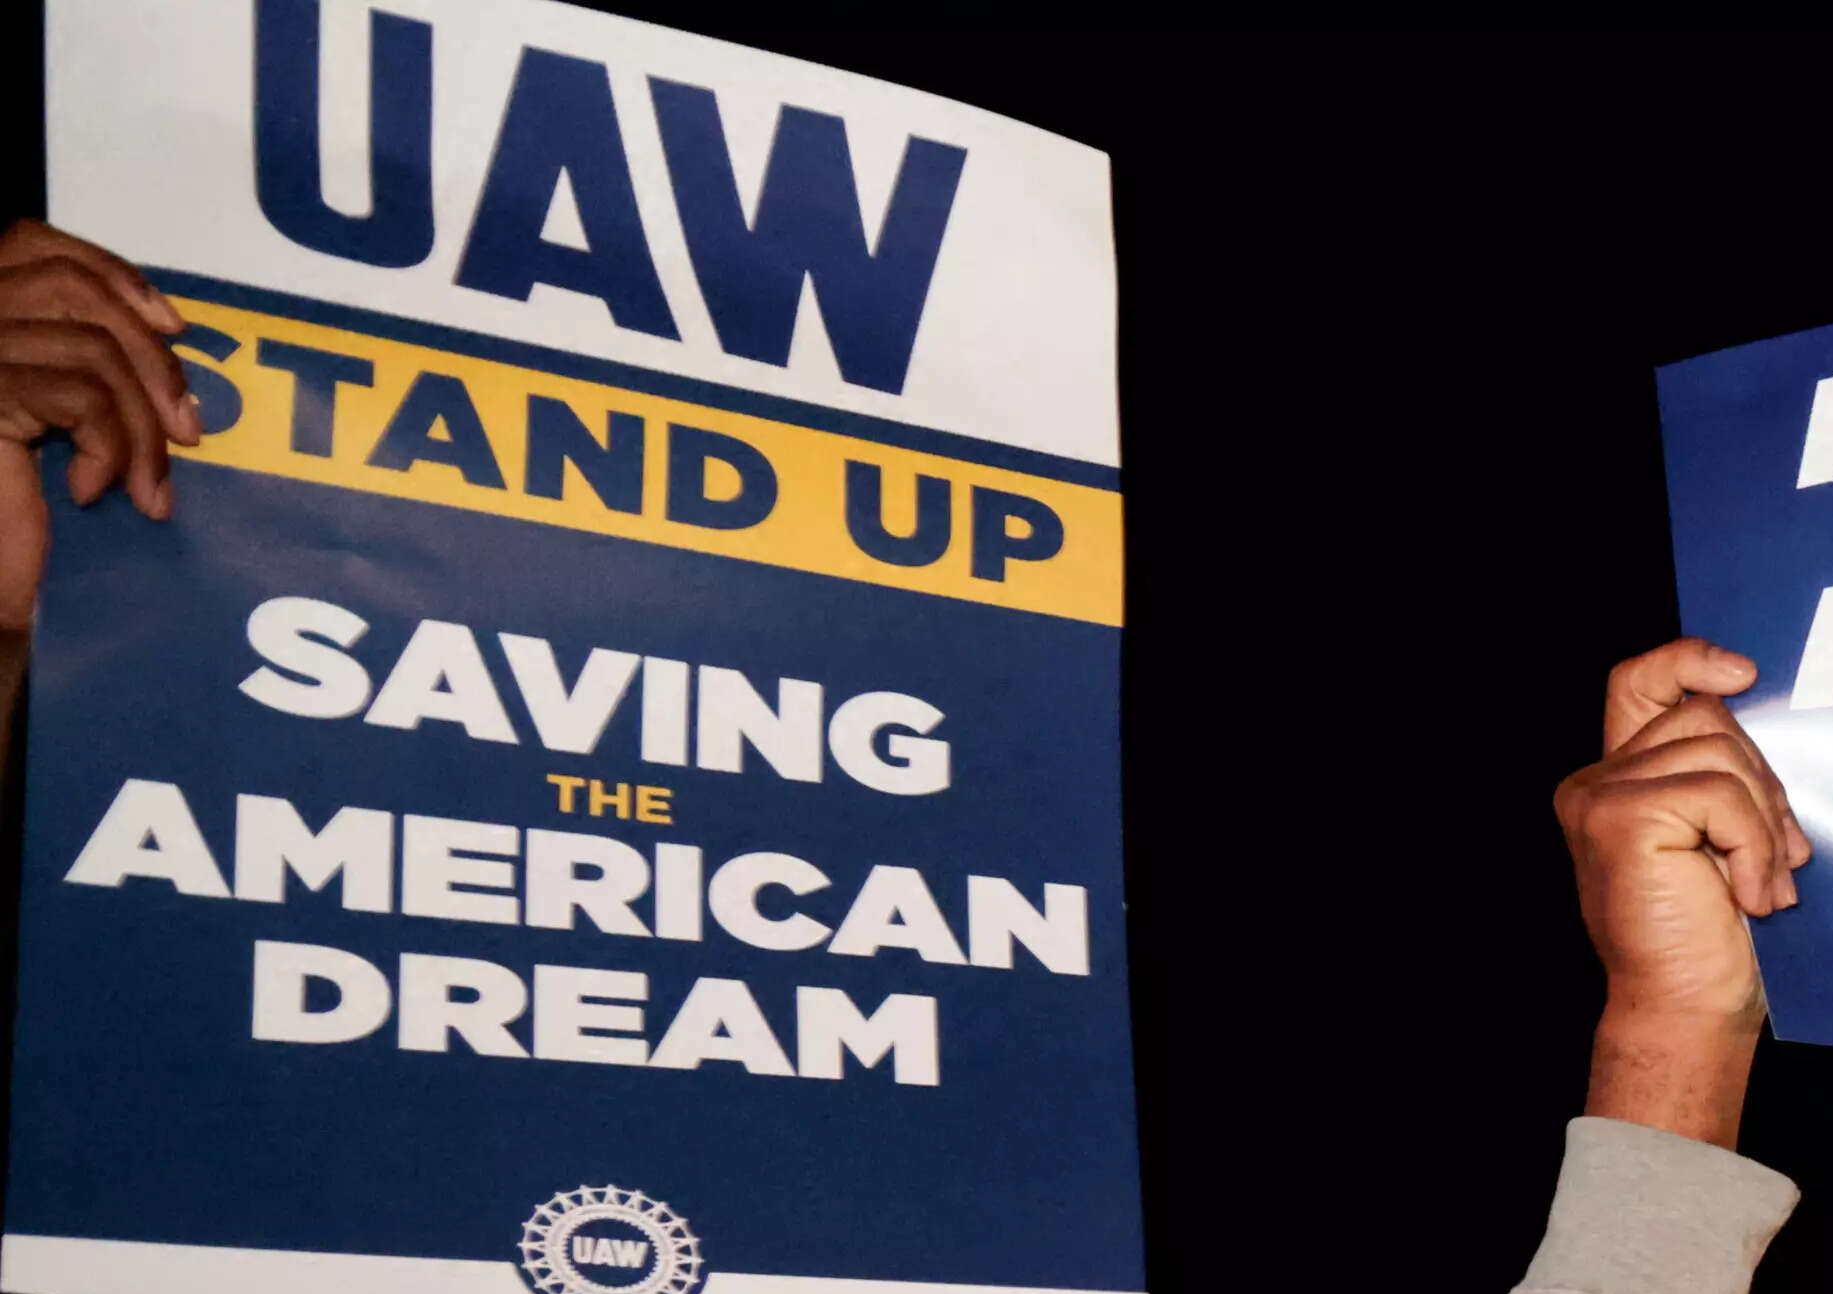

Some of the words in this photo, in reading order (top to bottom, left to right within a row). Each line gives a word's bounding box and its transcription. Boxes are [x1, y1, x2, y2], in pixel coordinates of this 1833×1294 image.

[254, 0, 967, 396] UAW
[167, 322, 779, 532] STAND
[843, 459, 1065, 584] UP
[237, 596, 951, 796] SAVING
[62, 777, 1090, 976] AMERICAN
[545, 773, 674, 825] THE
[251, 940, 940, 1086] DREAM
[571, 1235, 649, 1269] UAW
